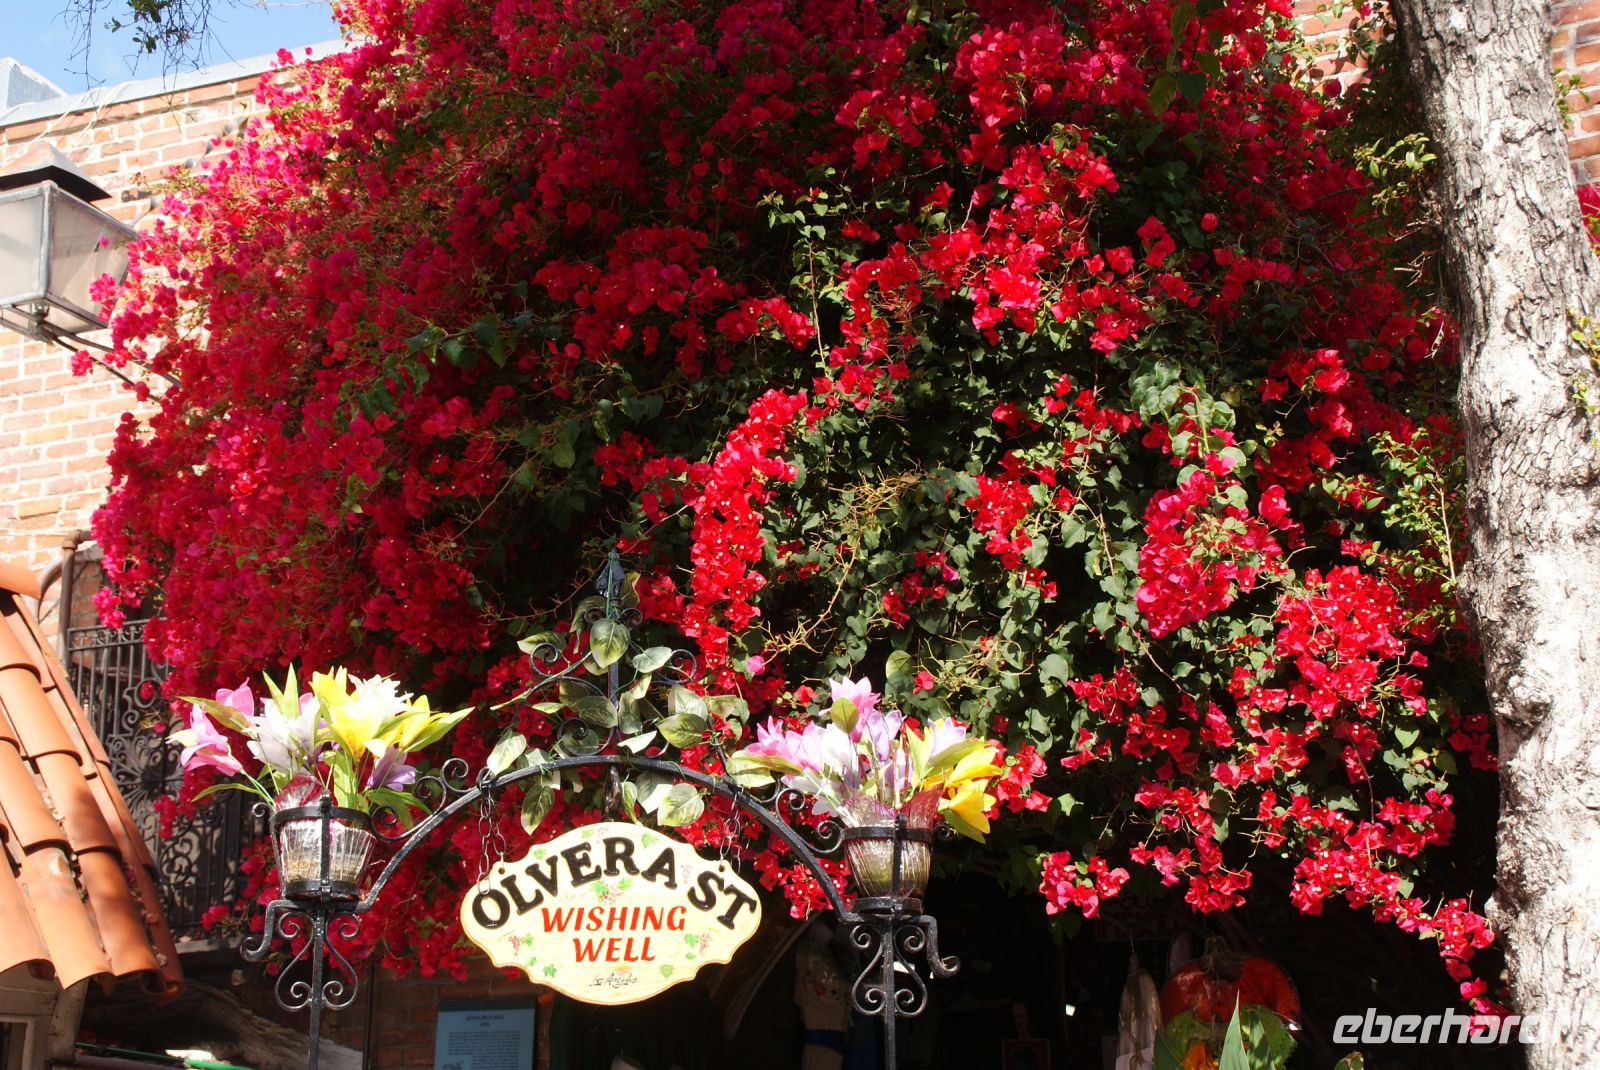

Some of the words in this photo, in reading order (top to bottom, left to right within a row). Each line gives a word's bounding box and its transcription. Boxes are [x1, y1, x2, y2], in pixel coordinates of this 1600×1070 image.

[473, 837, 678, 929] OLVERA
[687, 870, 758, 930] ST
[541, 905, 688, 933] WISHING
[572, 937, 656, 963] WELL
